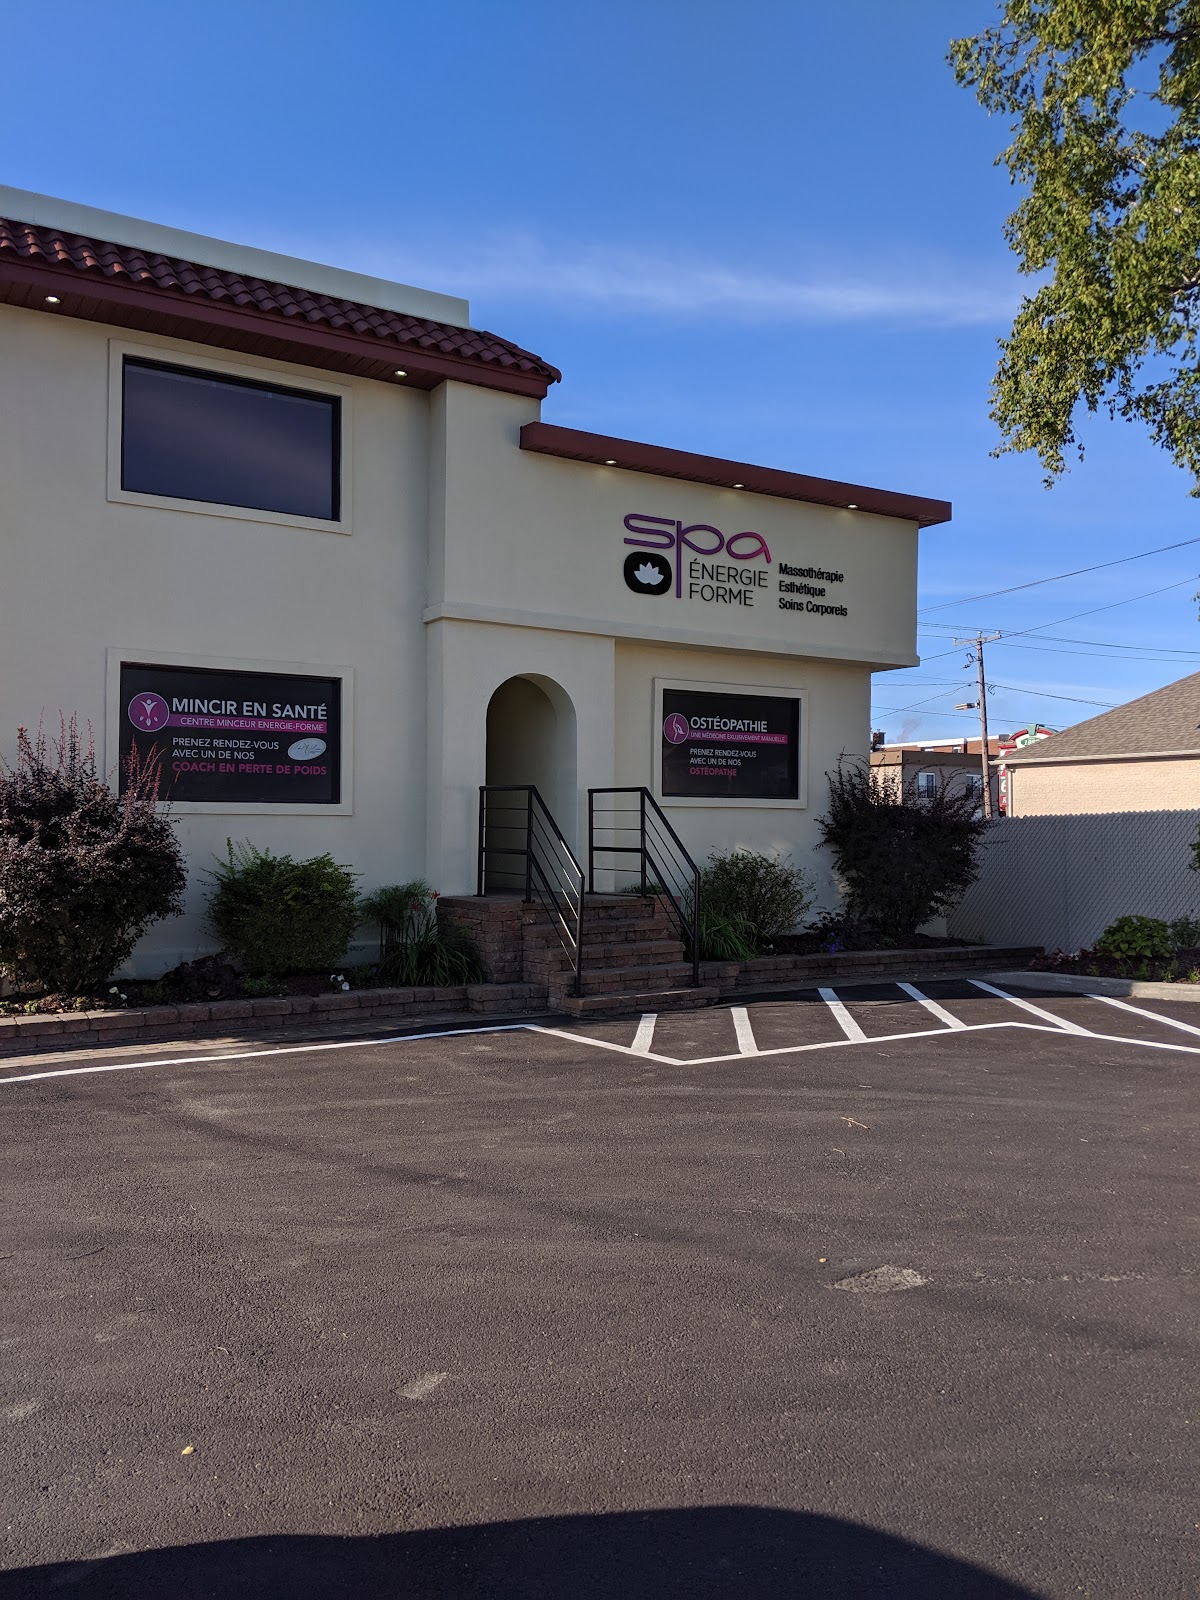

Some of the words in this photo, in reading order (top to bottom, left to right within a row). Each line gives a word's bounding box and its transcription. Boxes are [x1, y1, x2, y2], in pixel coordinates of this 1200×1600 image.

[689, 558, 769, 588] ÉNERGIE
[779, 562, 844, 583] Massothérapie
[689, 582, 754, 607] FORME
[779, 580, 826, 597] Esthétique
[779, 597, 804, 611] Soins
[806, 600, 848, 617] Corporels
[172, 697, 237, 715] MINCIR
[243, 701, 267, 717] EN
[272, 703, 328, 720] SANTÉ
[180, 717, 215, 726] CENTRE
[216, 718, 256, 728] MINCEUR
[258, 721, 324, 731] ENERGIE-FORME
[690, 716, 768, 732] OSTÉOPATHIE
[172, 737, 211, 747] PRENEZ
[213, 739, 280, 750] RENDEZ-VOUS
[172, 749, 199, 758] AVEC
[201, 750, 216, 759] UN
[218, 750, 232, 759] DE
[234, 751, 255, 760] NOS
[690, 748, 714, 756] PRENEZ
[715, 749, 756, 757] RENDEZ-VOUS
[172, 761, 216, 772] COACH
[219, 762, 236, 773] EN
[238, 763, 273, 774] PERTE
[275, 764, 291, 774] DE
[294, 765, 327, 776] POIDS
[690, 766, 737, 776] OSTÉOPATHE
